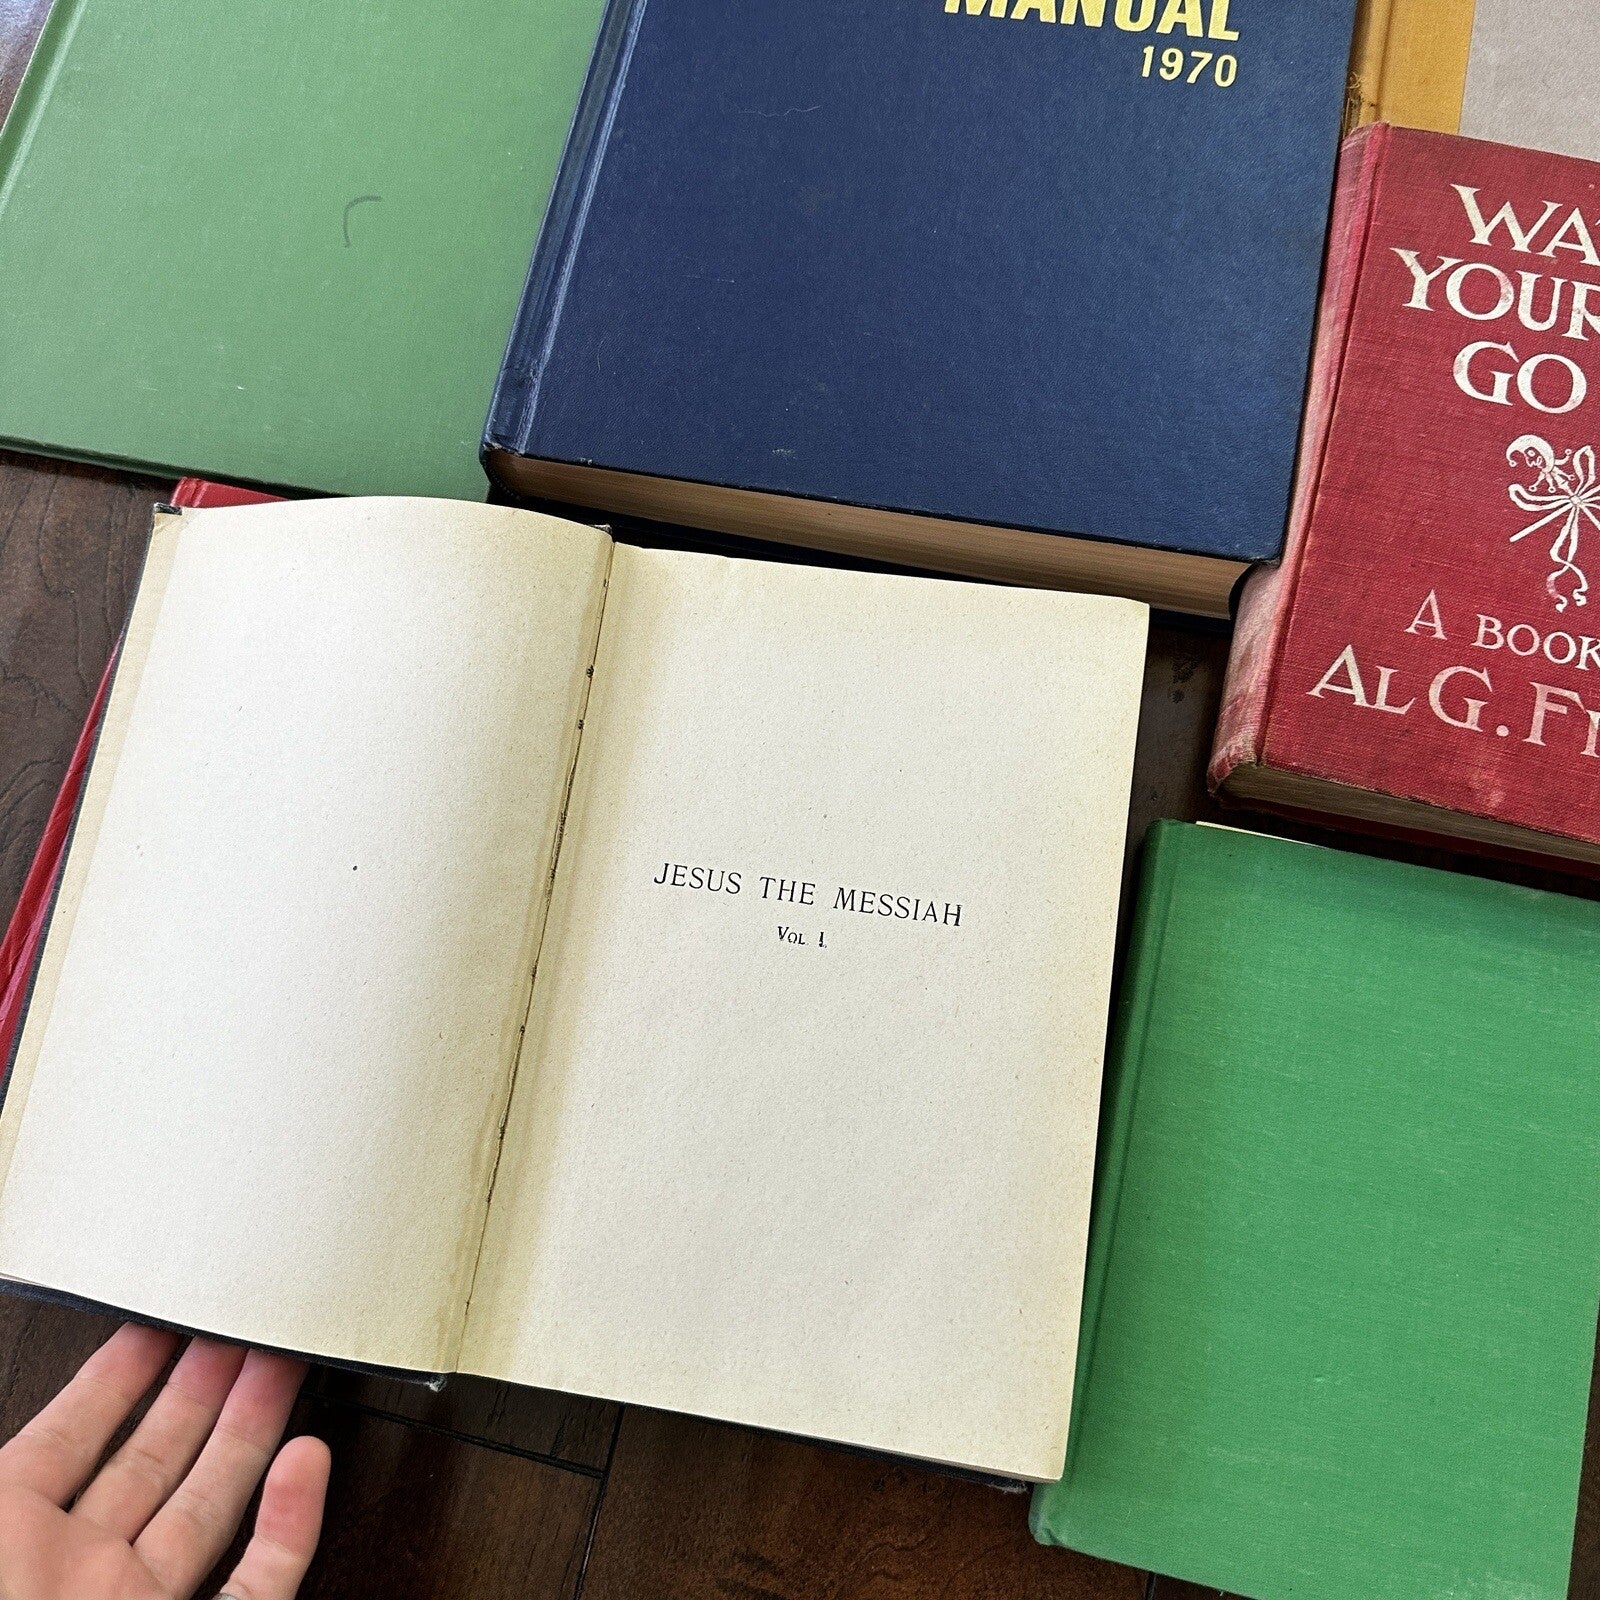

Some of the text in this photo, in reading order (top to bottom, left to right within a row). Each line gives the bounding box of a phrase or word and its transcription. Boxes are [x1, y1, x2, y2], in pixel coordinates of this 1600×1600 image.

[1142, 46, 1238, 88] 1970
[1450, 183, 1600, 267] WA
[1453, 341, 1587, 414] GO
[1404, 589, 1600, 671] A BOOK
[1306, 643, 1416, 715] AL
[653, 863, 963, 927] JESUS THE MESSIAH
